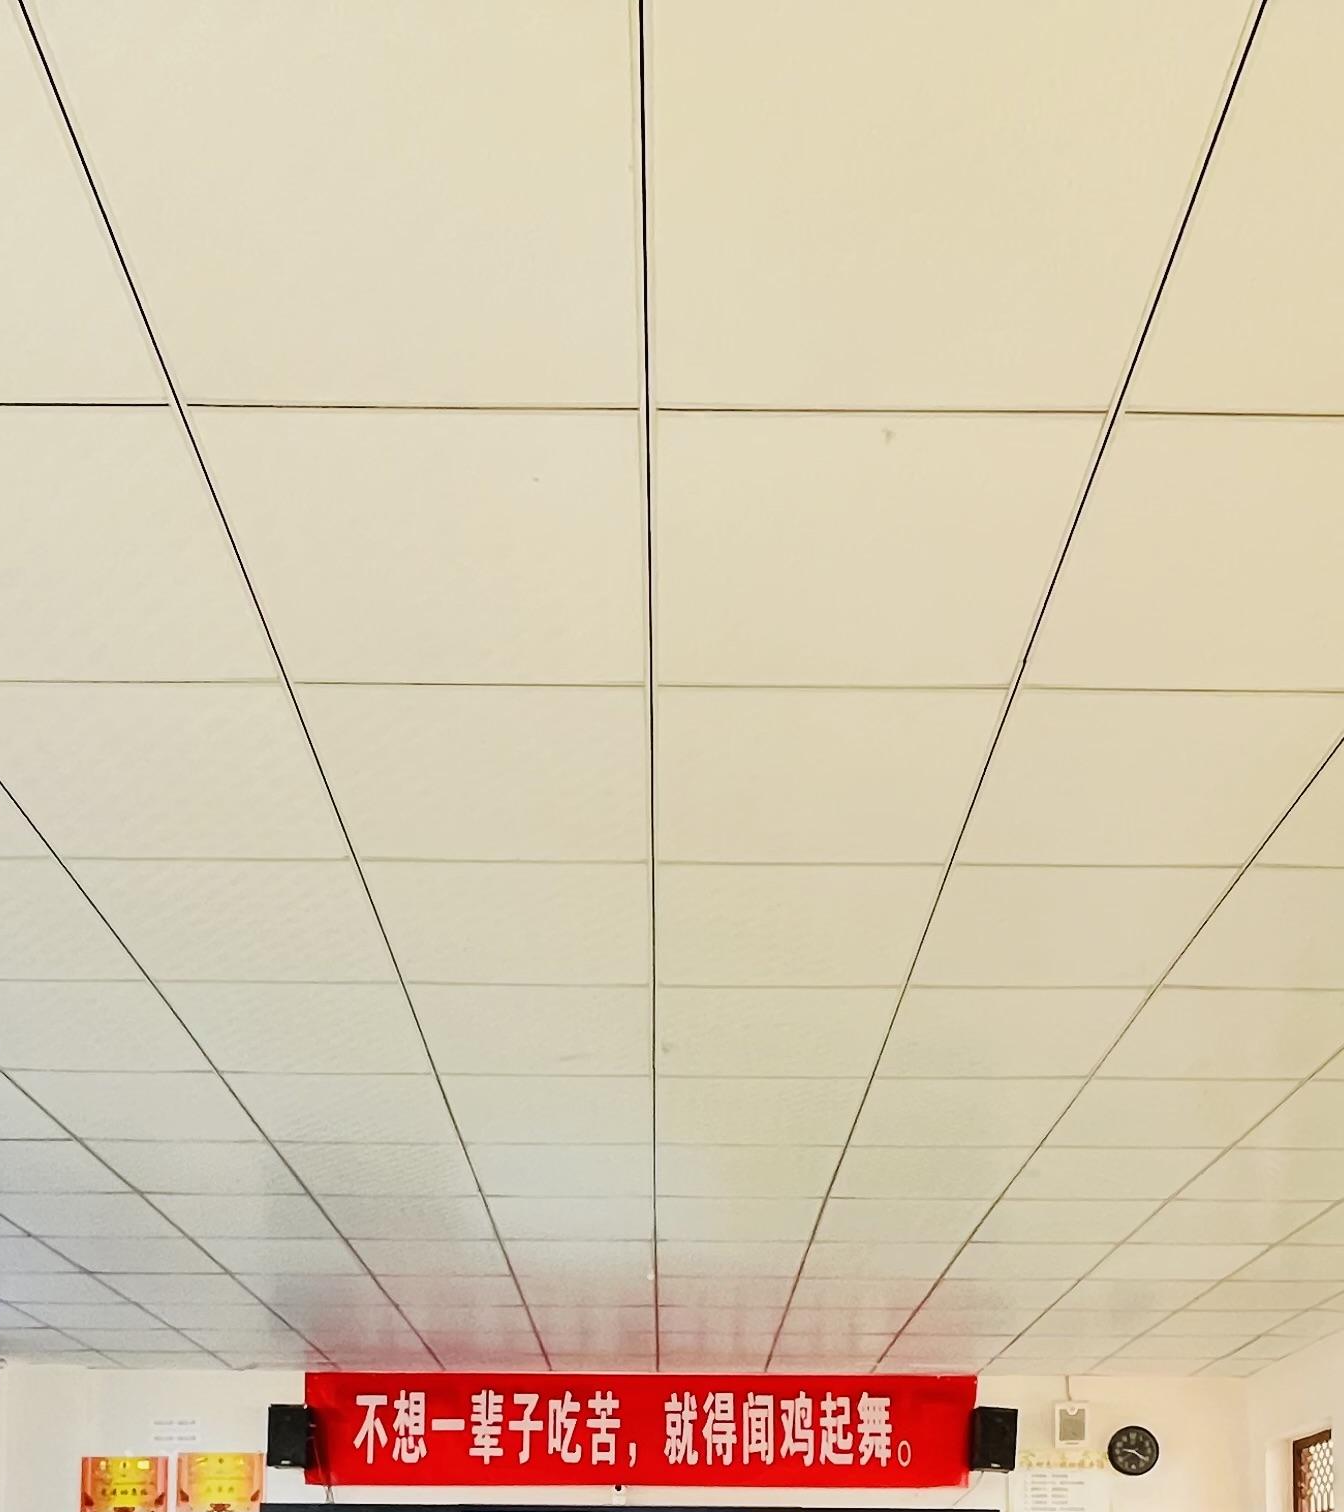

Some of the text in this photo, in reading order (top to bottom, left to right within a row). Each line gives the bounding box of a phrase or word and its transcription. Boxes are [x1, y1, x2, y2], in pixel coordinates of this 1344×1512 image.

[354, 1389, 912, 1468] 不想一辈子吃苦，就得闻鸡起舞。
